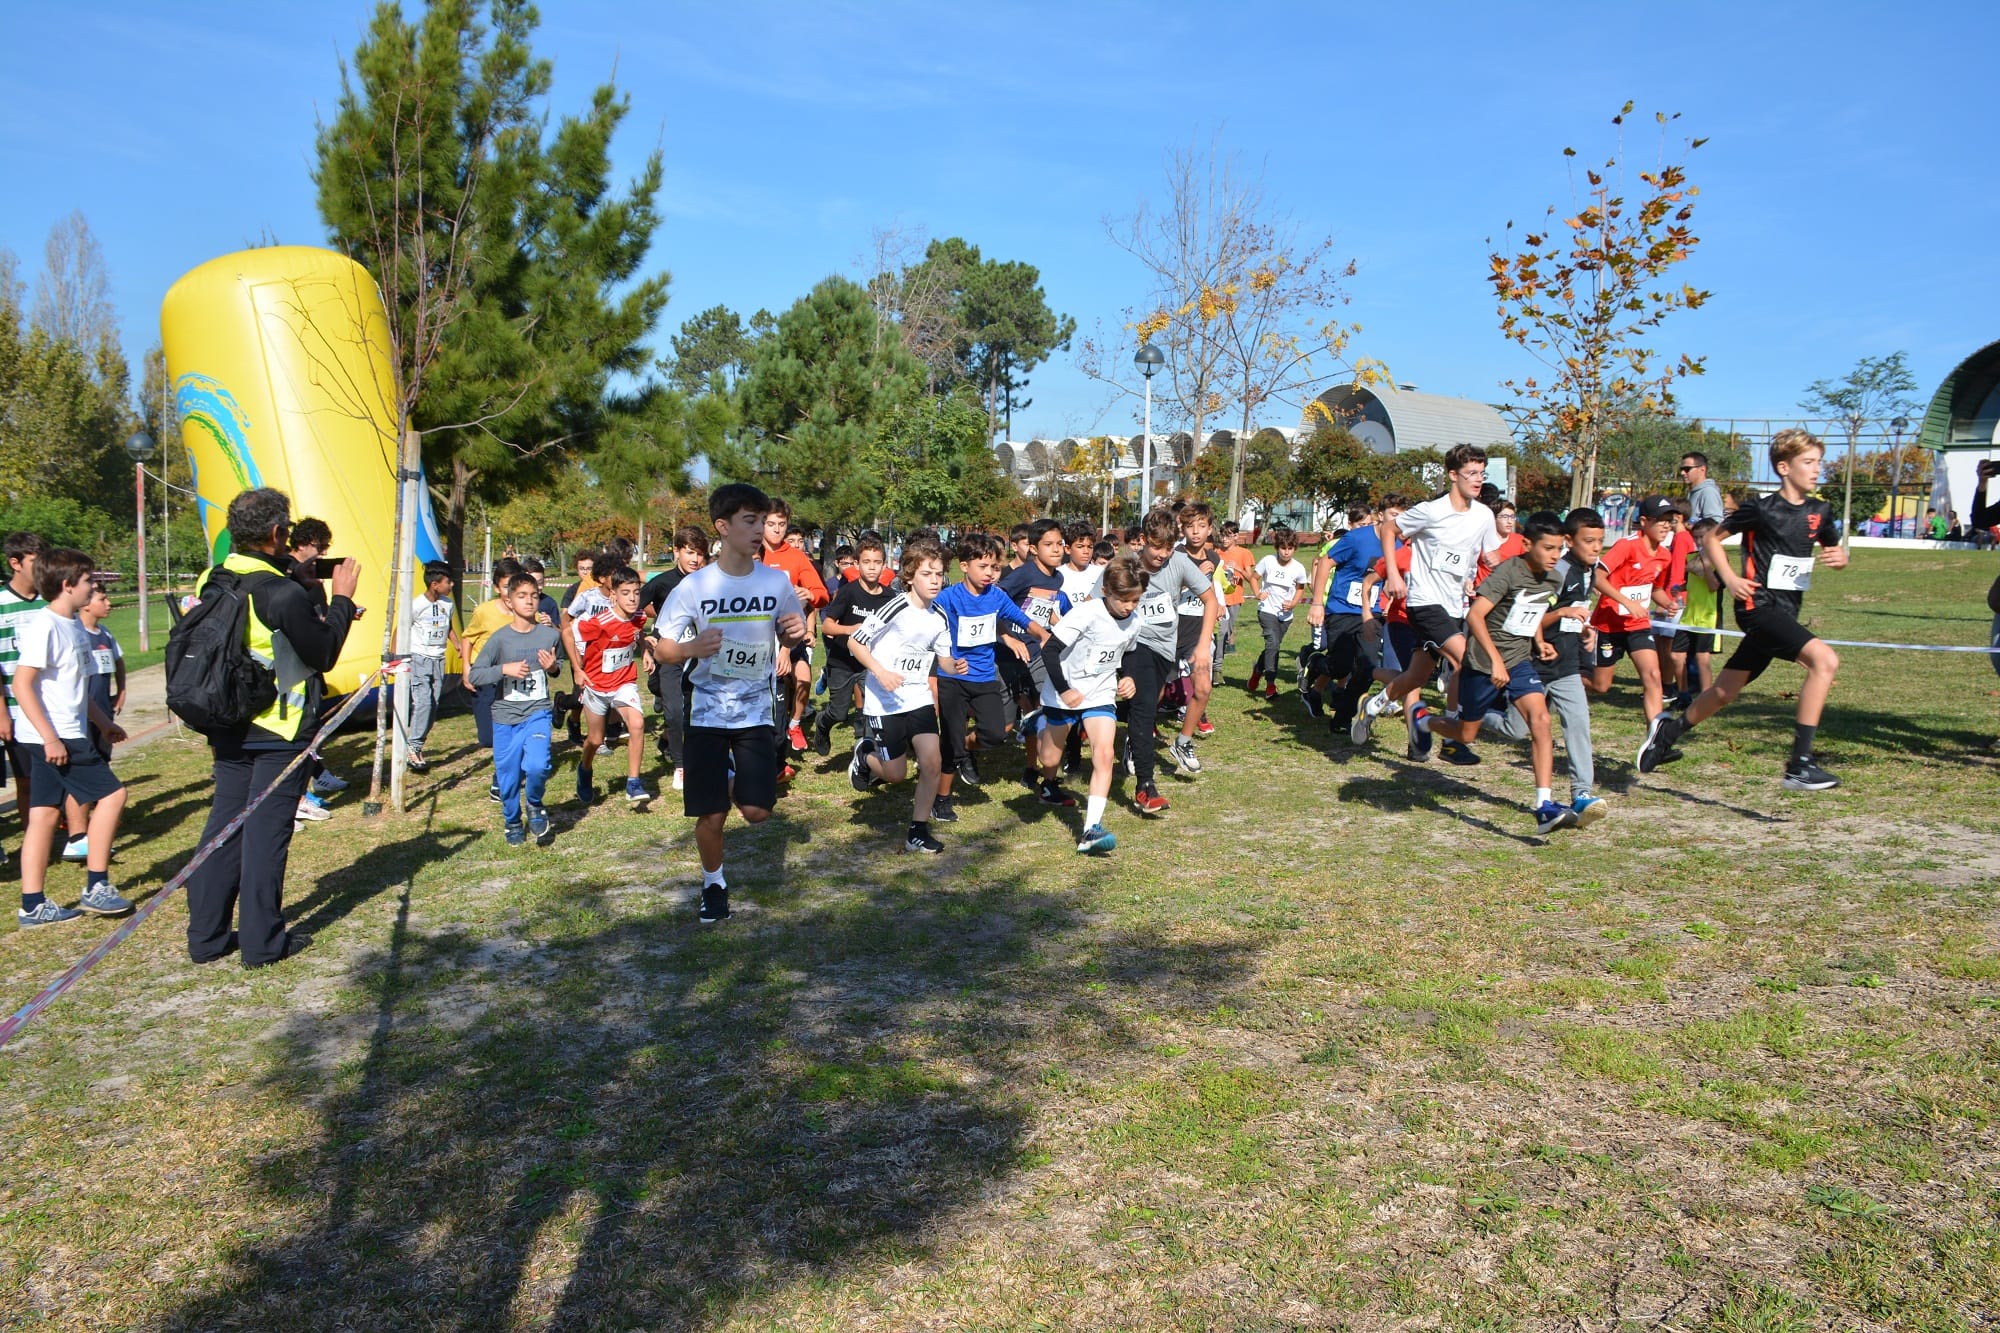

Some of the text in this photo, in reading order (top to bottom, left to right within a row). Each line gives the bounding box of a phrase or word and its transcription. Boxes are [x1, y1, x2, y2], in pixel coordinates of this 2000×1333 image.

[1445, 552, 1461, 565] 79
[1275, 570, 1285, 579] 25
[1782, 564, 1799, 578] 78
[1072, 592, 1085, 603] 33
[1032, 604, 1052, 619] 205
[1141, 603, 1165, 616] 116
[1520, 611, 1538, 624] 77
[428, 630, 444, 639] 143
[970, 623, 985, 637] 37
[100, 655, 110, 665] 52
[610, 652, 630, 664] 114
[725, 648, 757, 667] 194
[1098, 650, 1115, 664] 29
[901, 658, 922, 672] 104
[511, 679, 537, 690] 112
